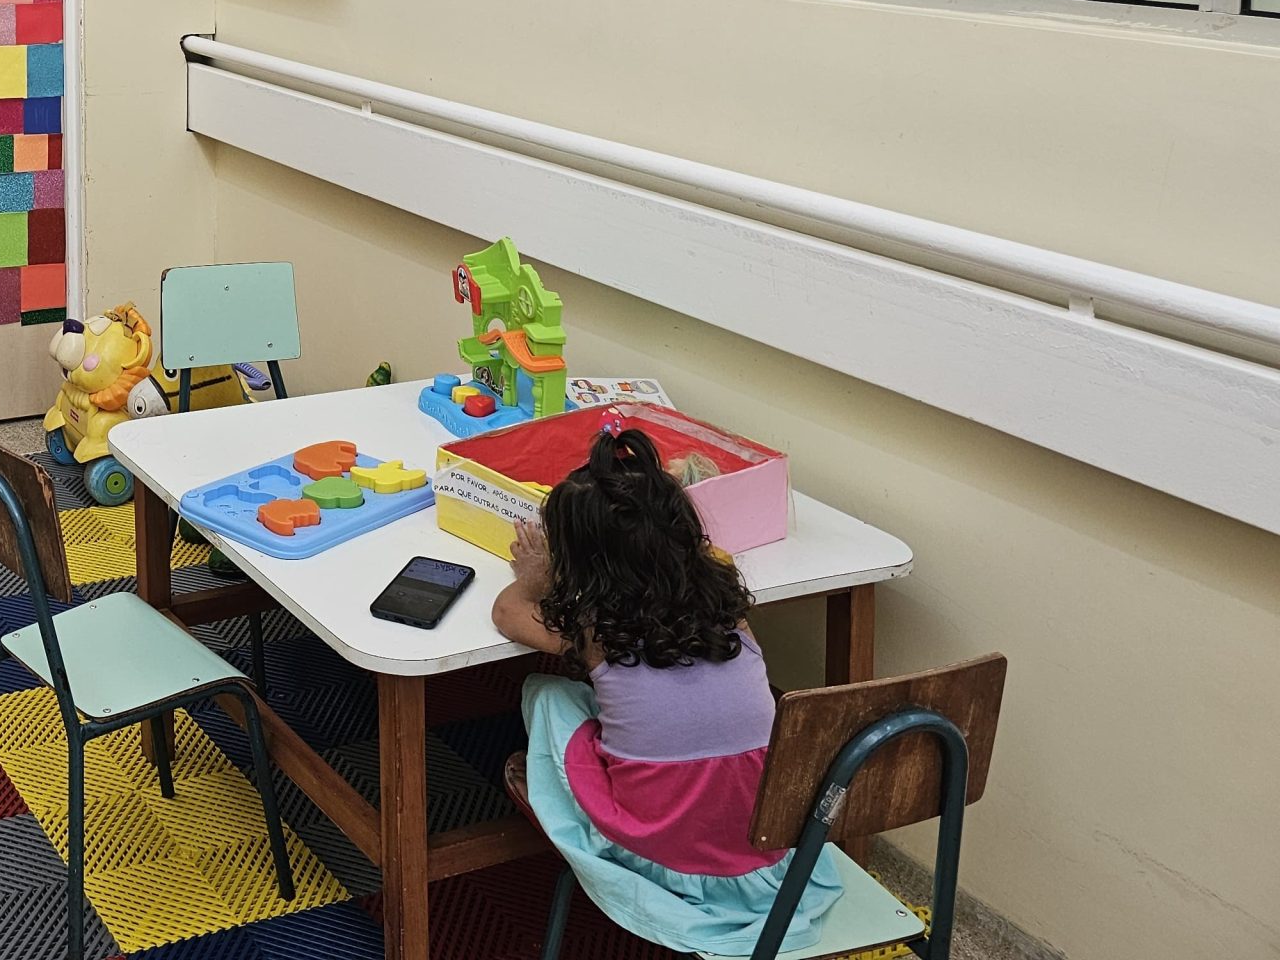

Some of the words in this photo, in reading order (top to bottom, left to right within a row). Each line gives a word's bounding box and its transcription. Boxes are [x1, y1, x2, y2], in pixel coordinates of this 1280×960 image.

[434, 484, 455, 494] PARA
[457, 488, 472, 500] QUE
[473, 495, 500, 512] OUTRAS
[451, 472, 465, 482] POR
[492, 489, 509, 502] APÓS
[510, 497, 517, 505] O
[518, 501, 534, 512] USO
